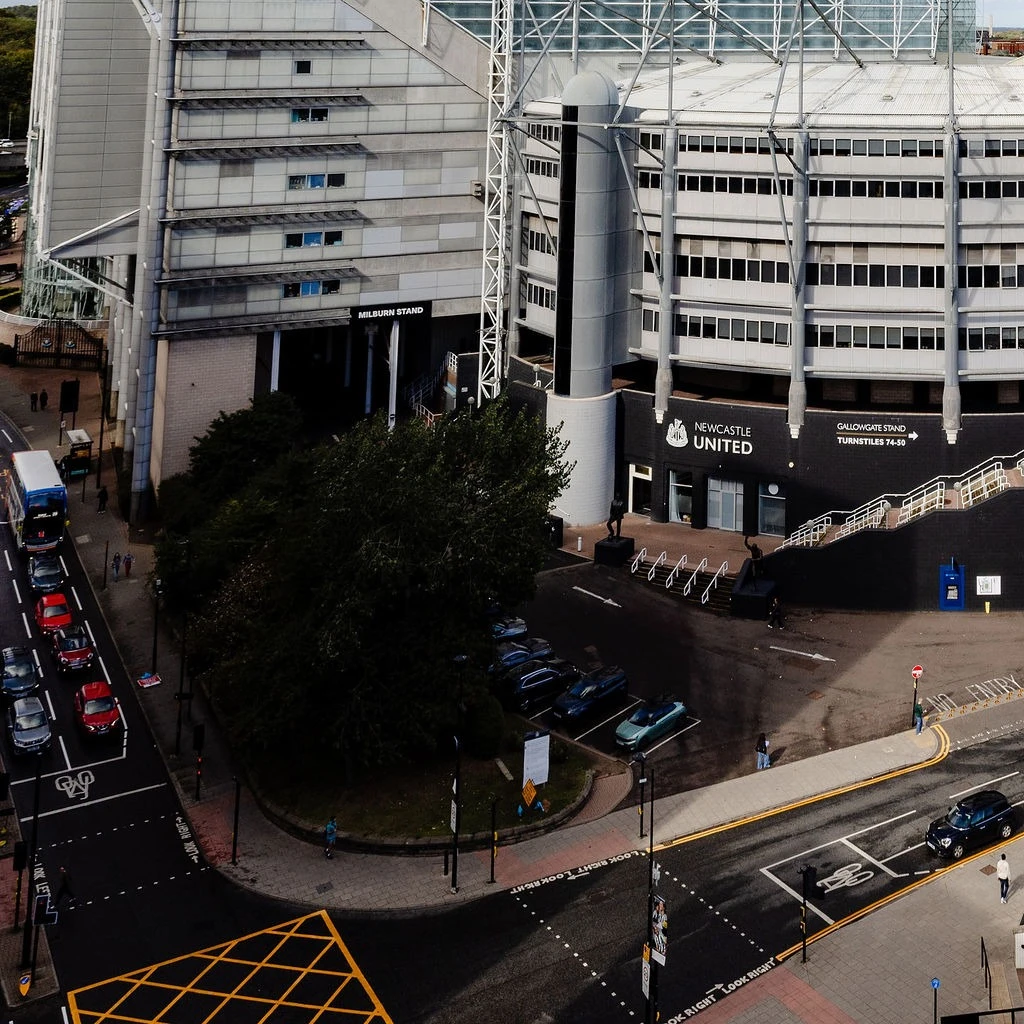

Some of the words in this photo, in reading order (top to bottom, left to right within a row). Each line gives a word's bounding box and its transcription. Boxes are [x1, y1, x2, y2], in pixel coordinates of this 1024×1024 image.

[358, 309, 395, 319] MILBURN
[396, 307, 424, 316] STAND
[694, 422, 751, 437] NEWCASTLE
[837, 423, 882, 431] GALLOWGATE
[883, 424, 906, 432] STAND
[693, 436, 753, 455] UNITED
[837, 437, 884, 446] TURNSTILES
[926, 693, 958, 713] NO
[965, 675, 1022, 701] ENTRY
[609, 850, 640, 864] LOOK
[577, 859, 609, 875] RIGHT
[541, 869, 573, 885] LOOK
[510, 879, 542, 894] RIGHT
[684, 994, 717, 1017] RIGHT
[721, 975, 750, 995] LOOK
[746, 957, 777, 980] RIGHT
